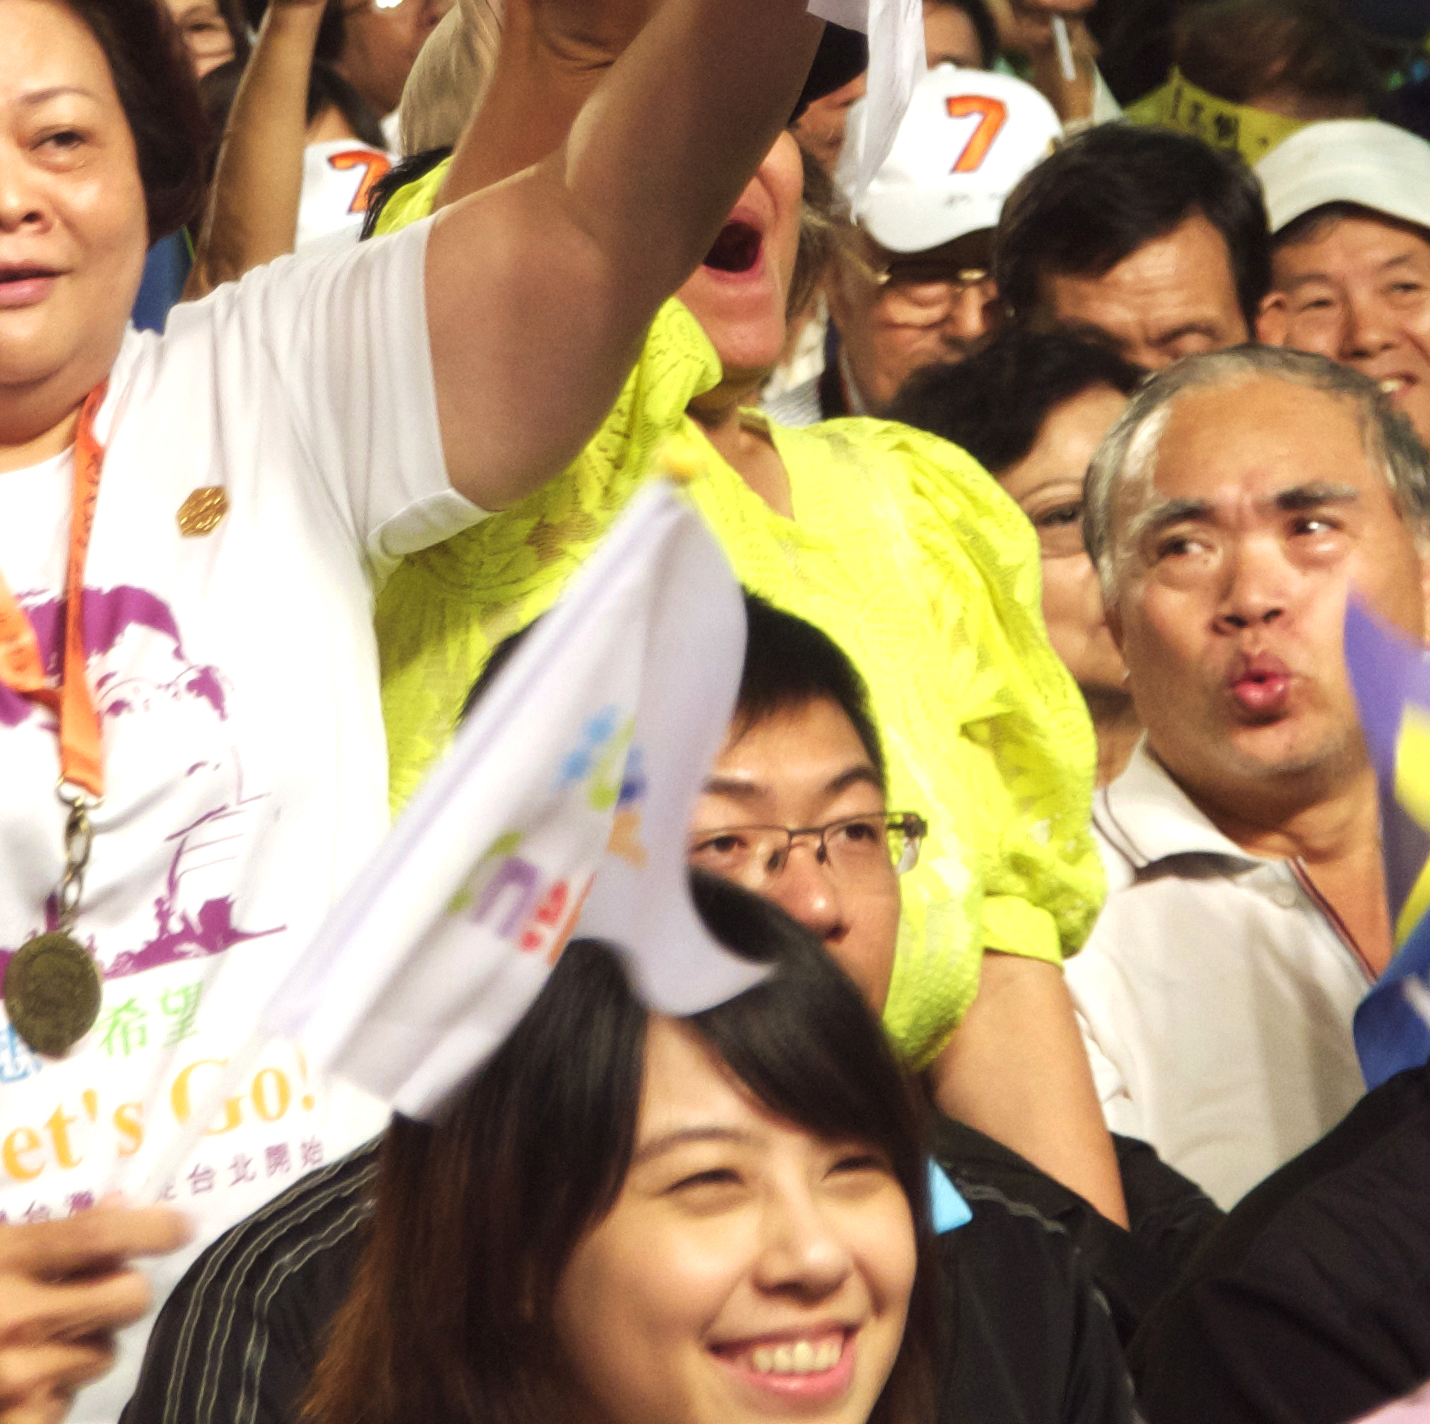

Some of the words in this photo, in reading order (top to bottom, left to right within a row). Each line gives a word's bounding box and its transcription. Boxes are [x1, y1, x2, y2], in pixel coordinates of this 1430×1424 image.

[944, 94, 1009, 175] 7
[170, 1046, 317, 1137] Go!
[155, 1134, 325, 1206] 台北開始
